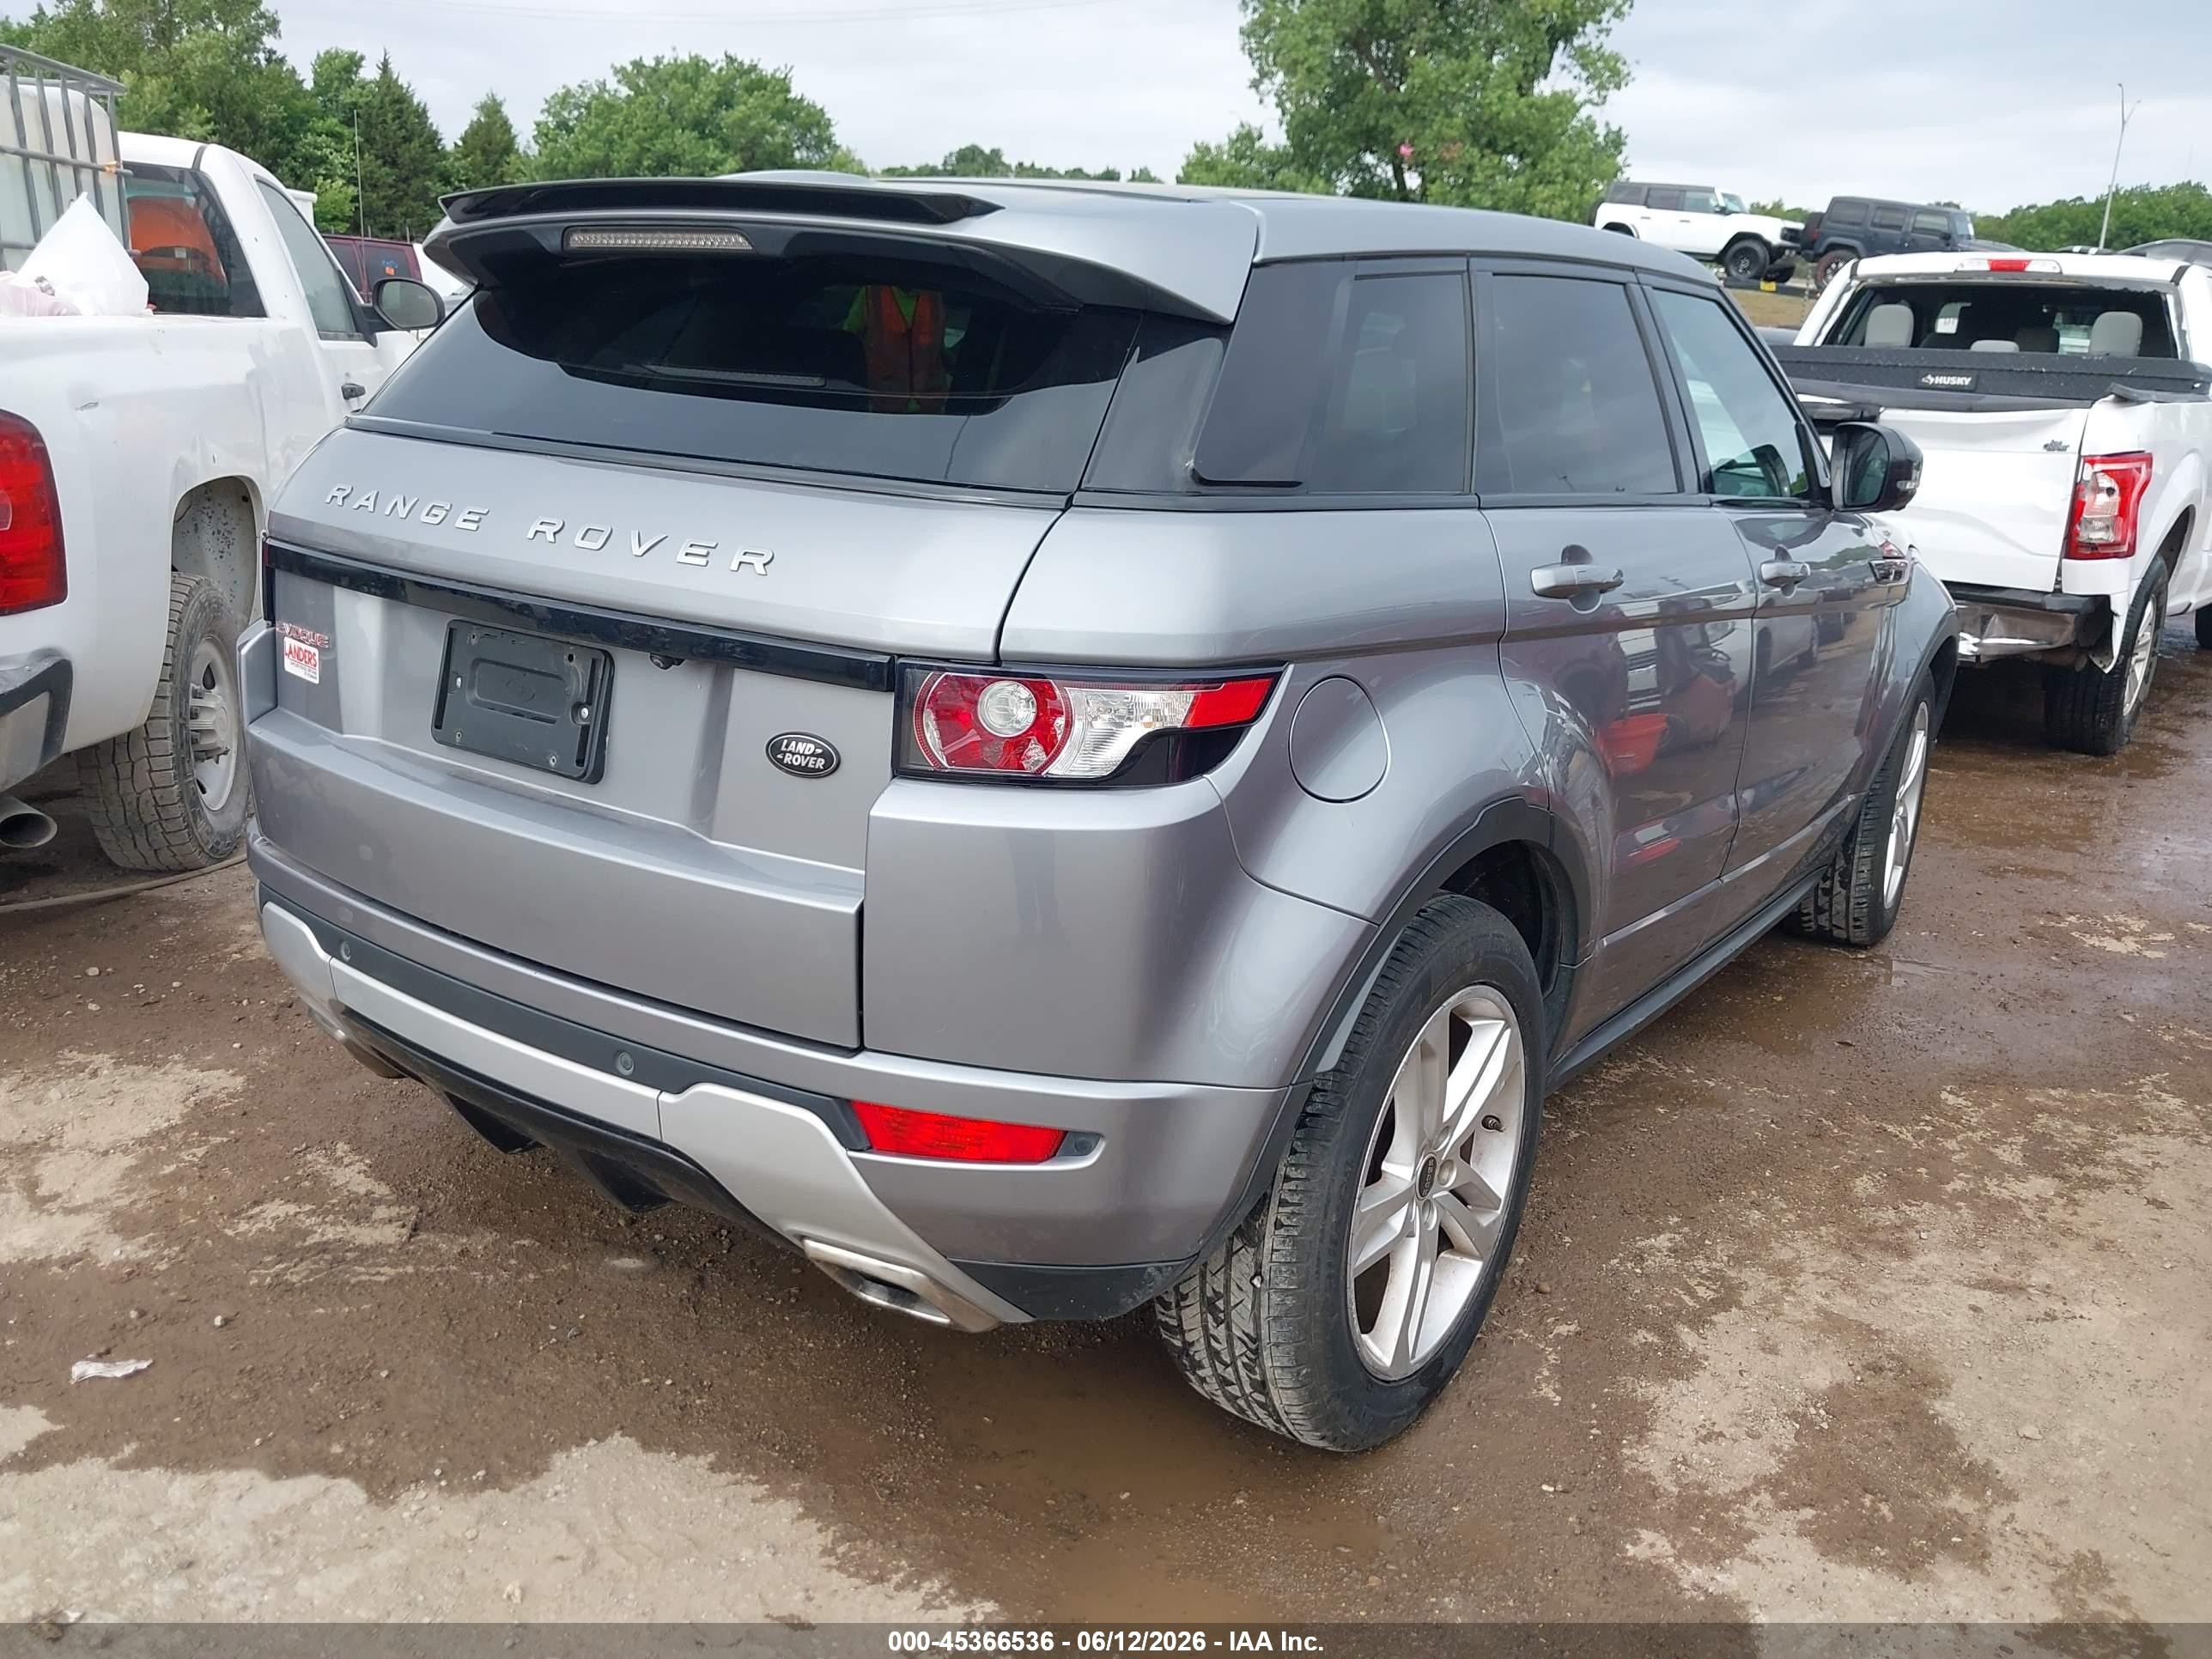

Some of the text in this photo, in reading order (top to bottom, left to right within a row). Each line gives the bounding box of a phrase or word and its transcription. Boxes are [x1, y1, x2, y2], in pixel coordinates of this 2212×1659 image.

[1935, 376, 1972, 386] HUSKY
[325, 484, 775, 576] RANGE ROVER
[781, 738, 816, 756] LAND
[782, 752, 825, 770] ROVER
